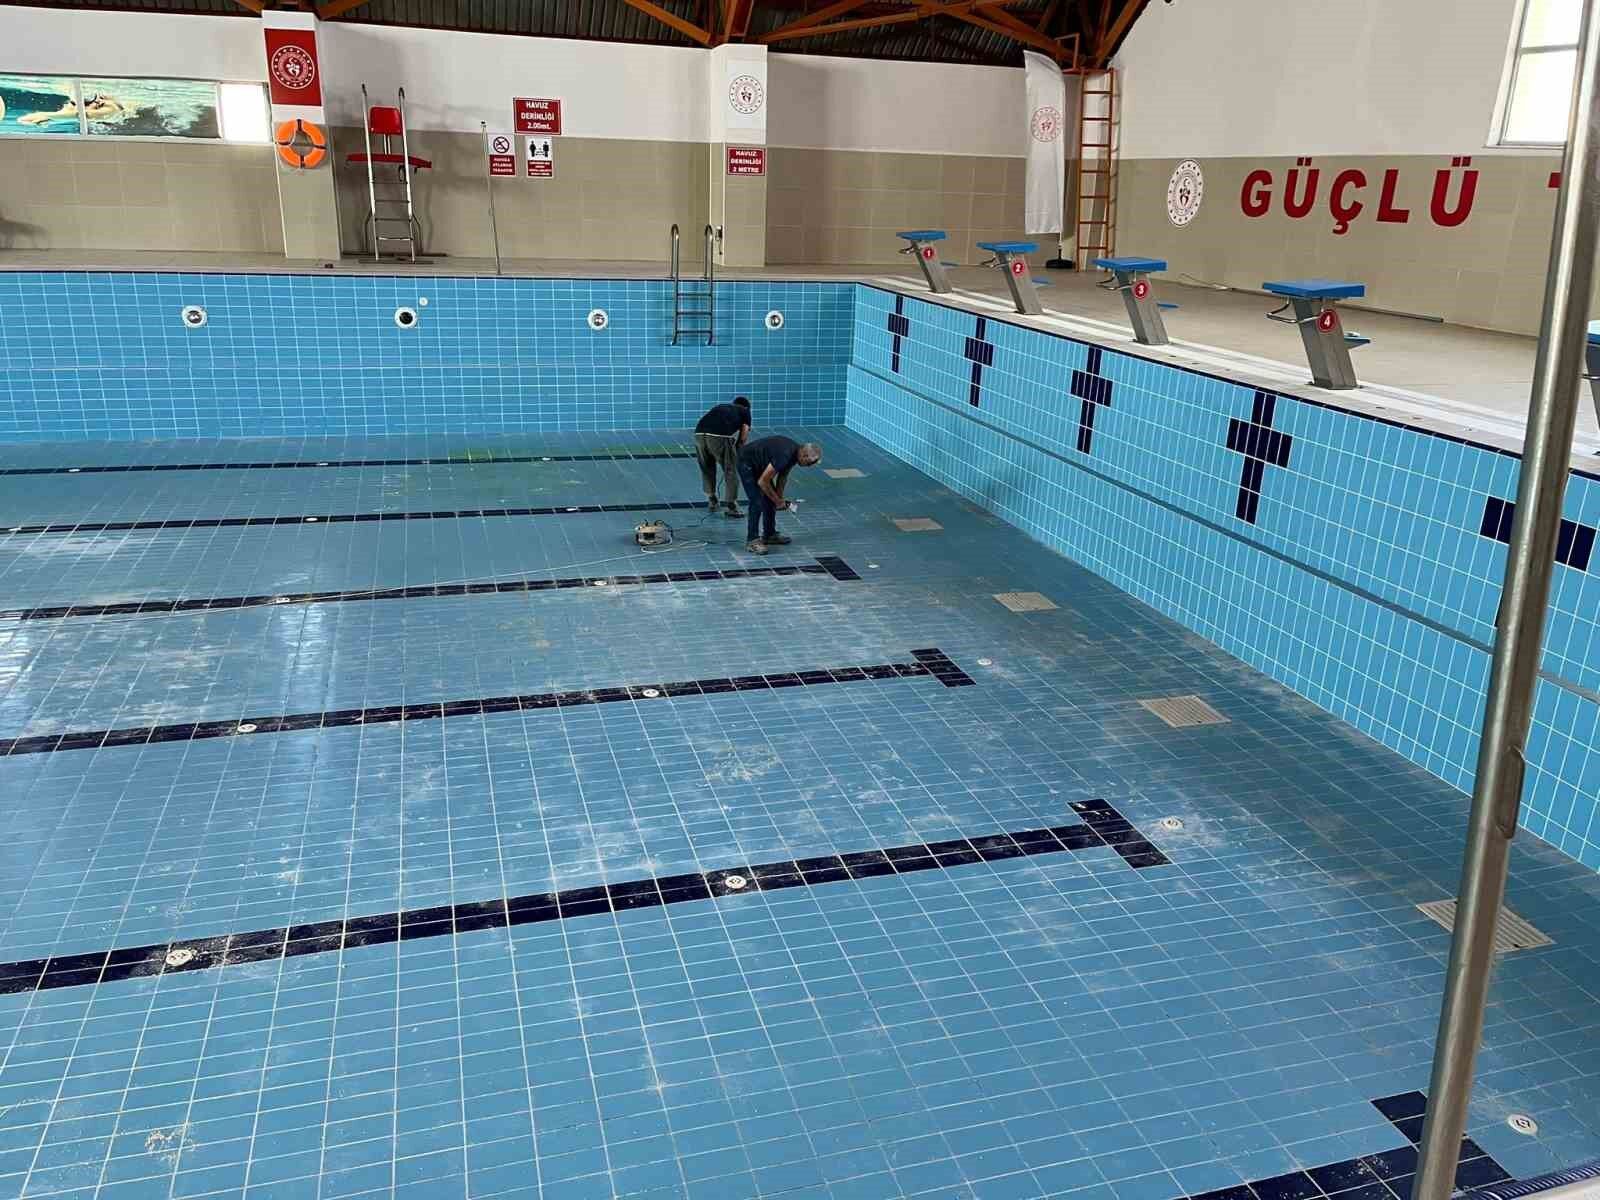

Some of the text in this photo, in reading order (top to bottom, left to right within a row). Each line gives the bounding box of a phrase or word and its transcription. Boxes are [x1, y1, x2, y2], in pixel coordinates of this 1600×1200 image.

[1240, 156, 1480, 235] GÜÇLÜ
[1015, 264, 1021, 272] 2
[1138, 284, 1145, 294] 3
[1323, 314, 1331, 327] 4
